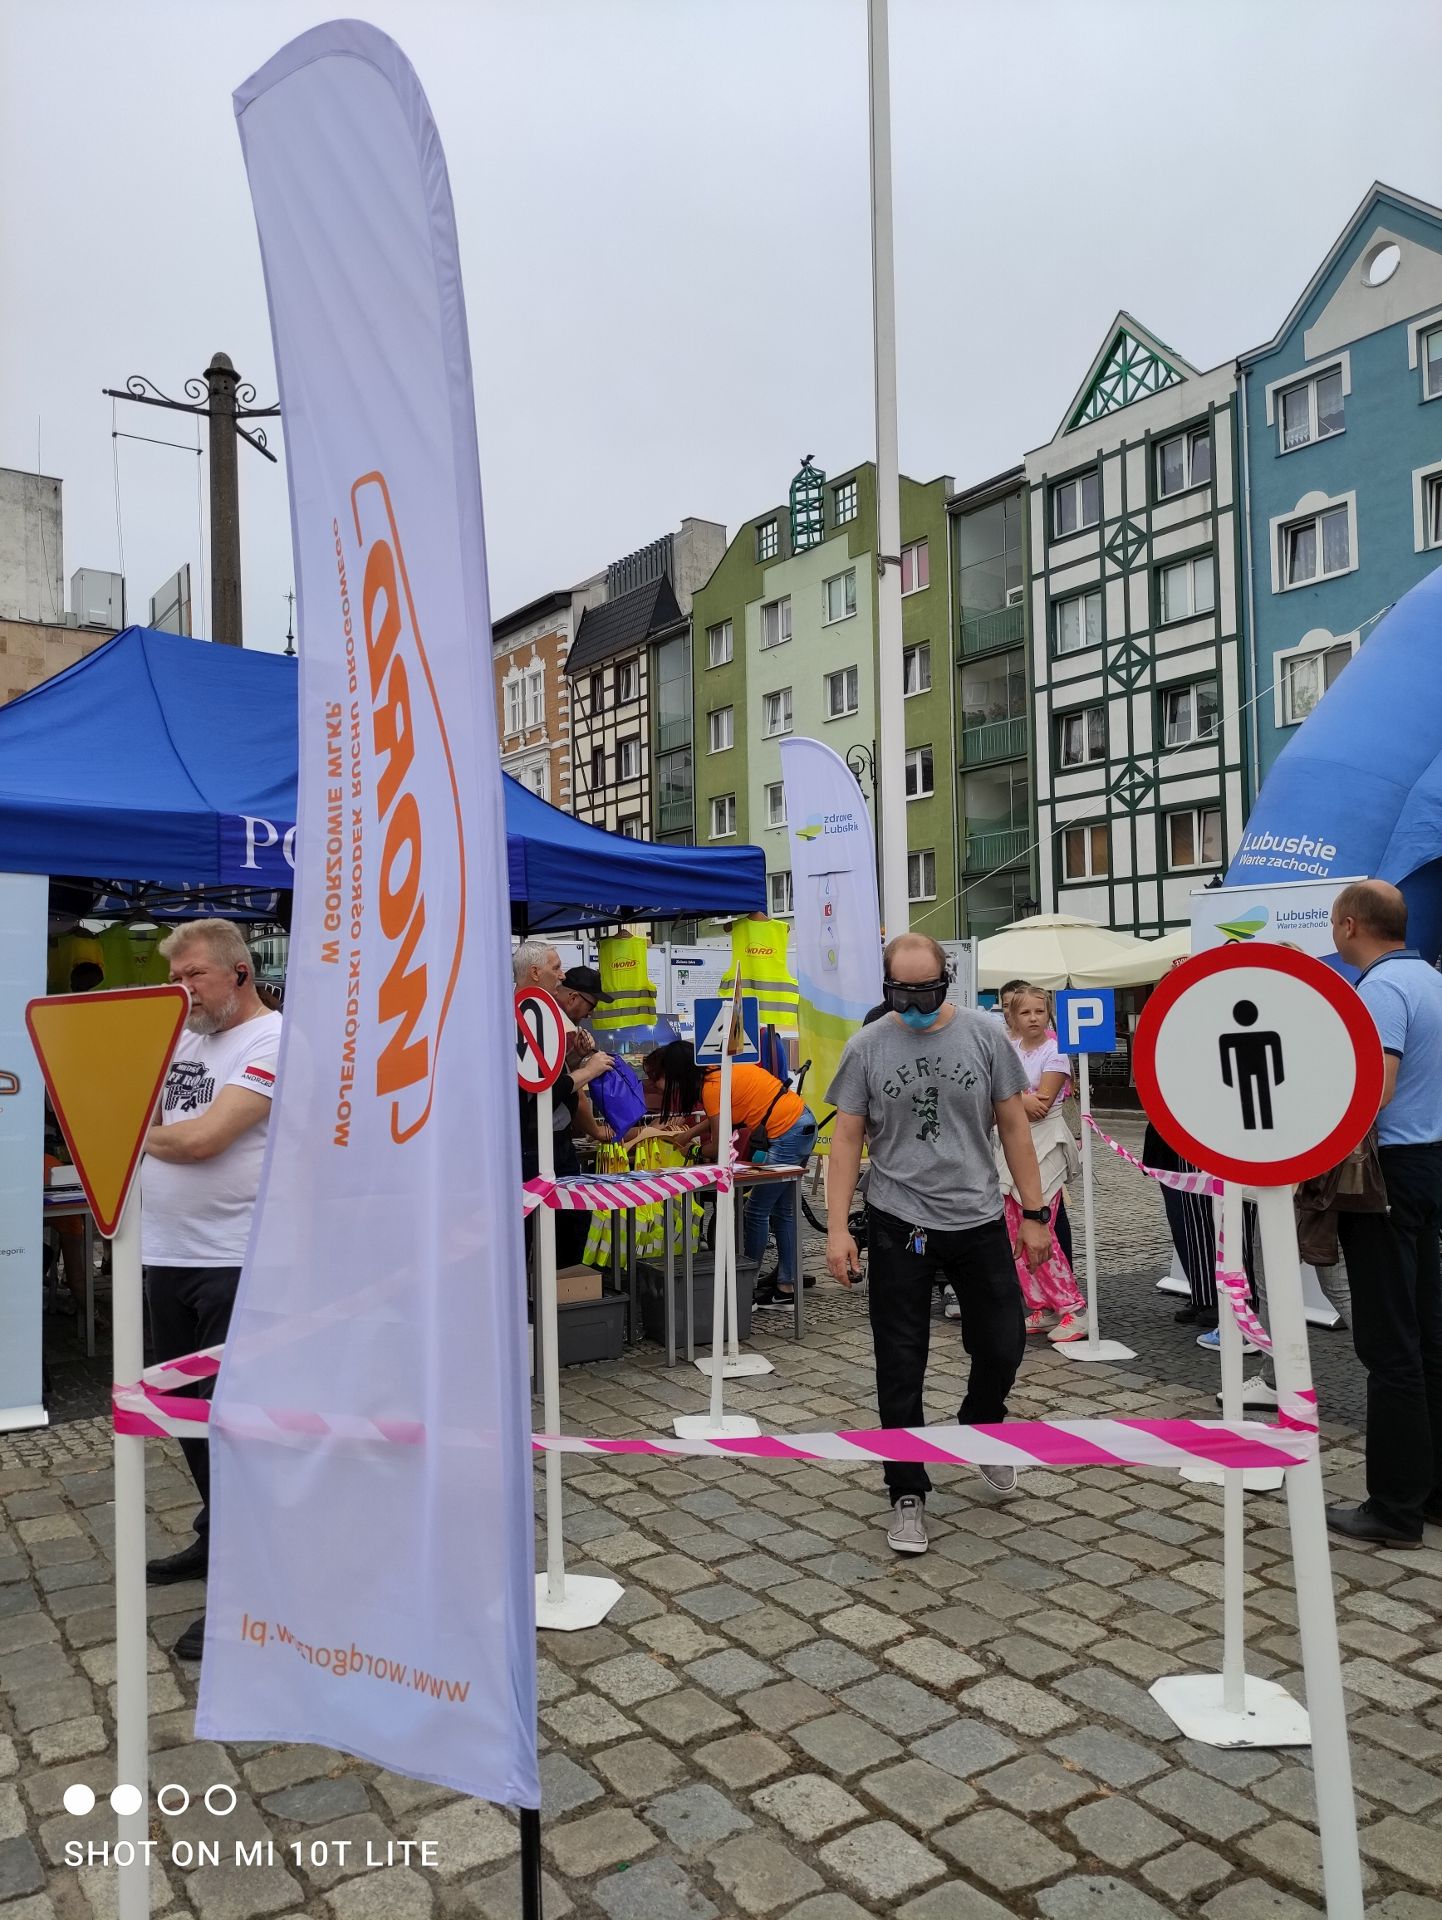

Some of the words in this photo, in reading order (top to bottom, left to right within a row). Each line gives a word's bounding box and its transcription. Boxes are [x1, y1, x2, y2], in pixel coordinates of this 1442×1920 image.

[1243, 831, 1337, 862] Lubuskie
[1239, 854, 1267, 865] Warte
[1267, 857, 1329, 877] zachodu
[1276, 908, 1329, 921] Lubuskie
[1277, 922, 1298, 930] Warte
[1298, 921, 1329, 930] zachodu
[1067, 998, 1104, 1045] P
